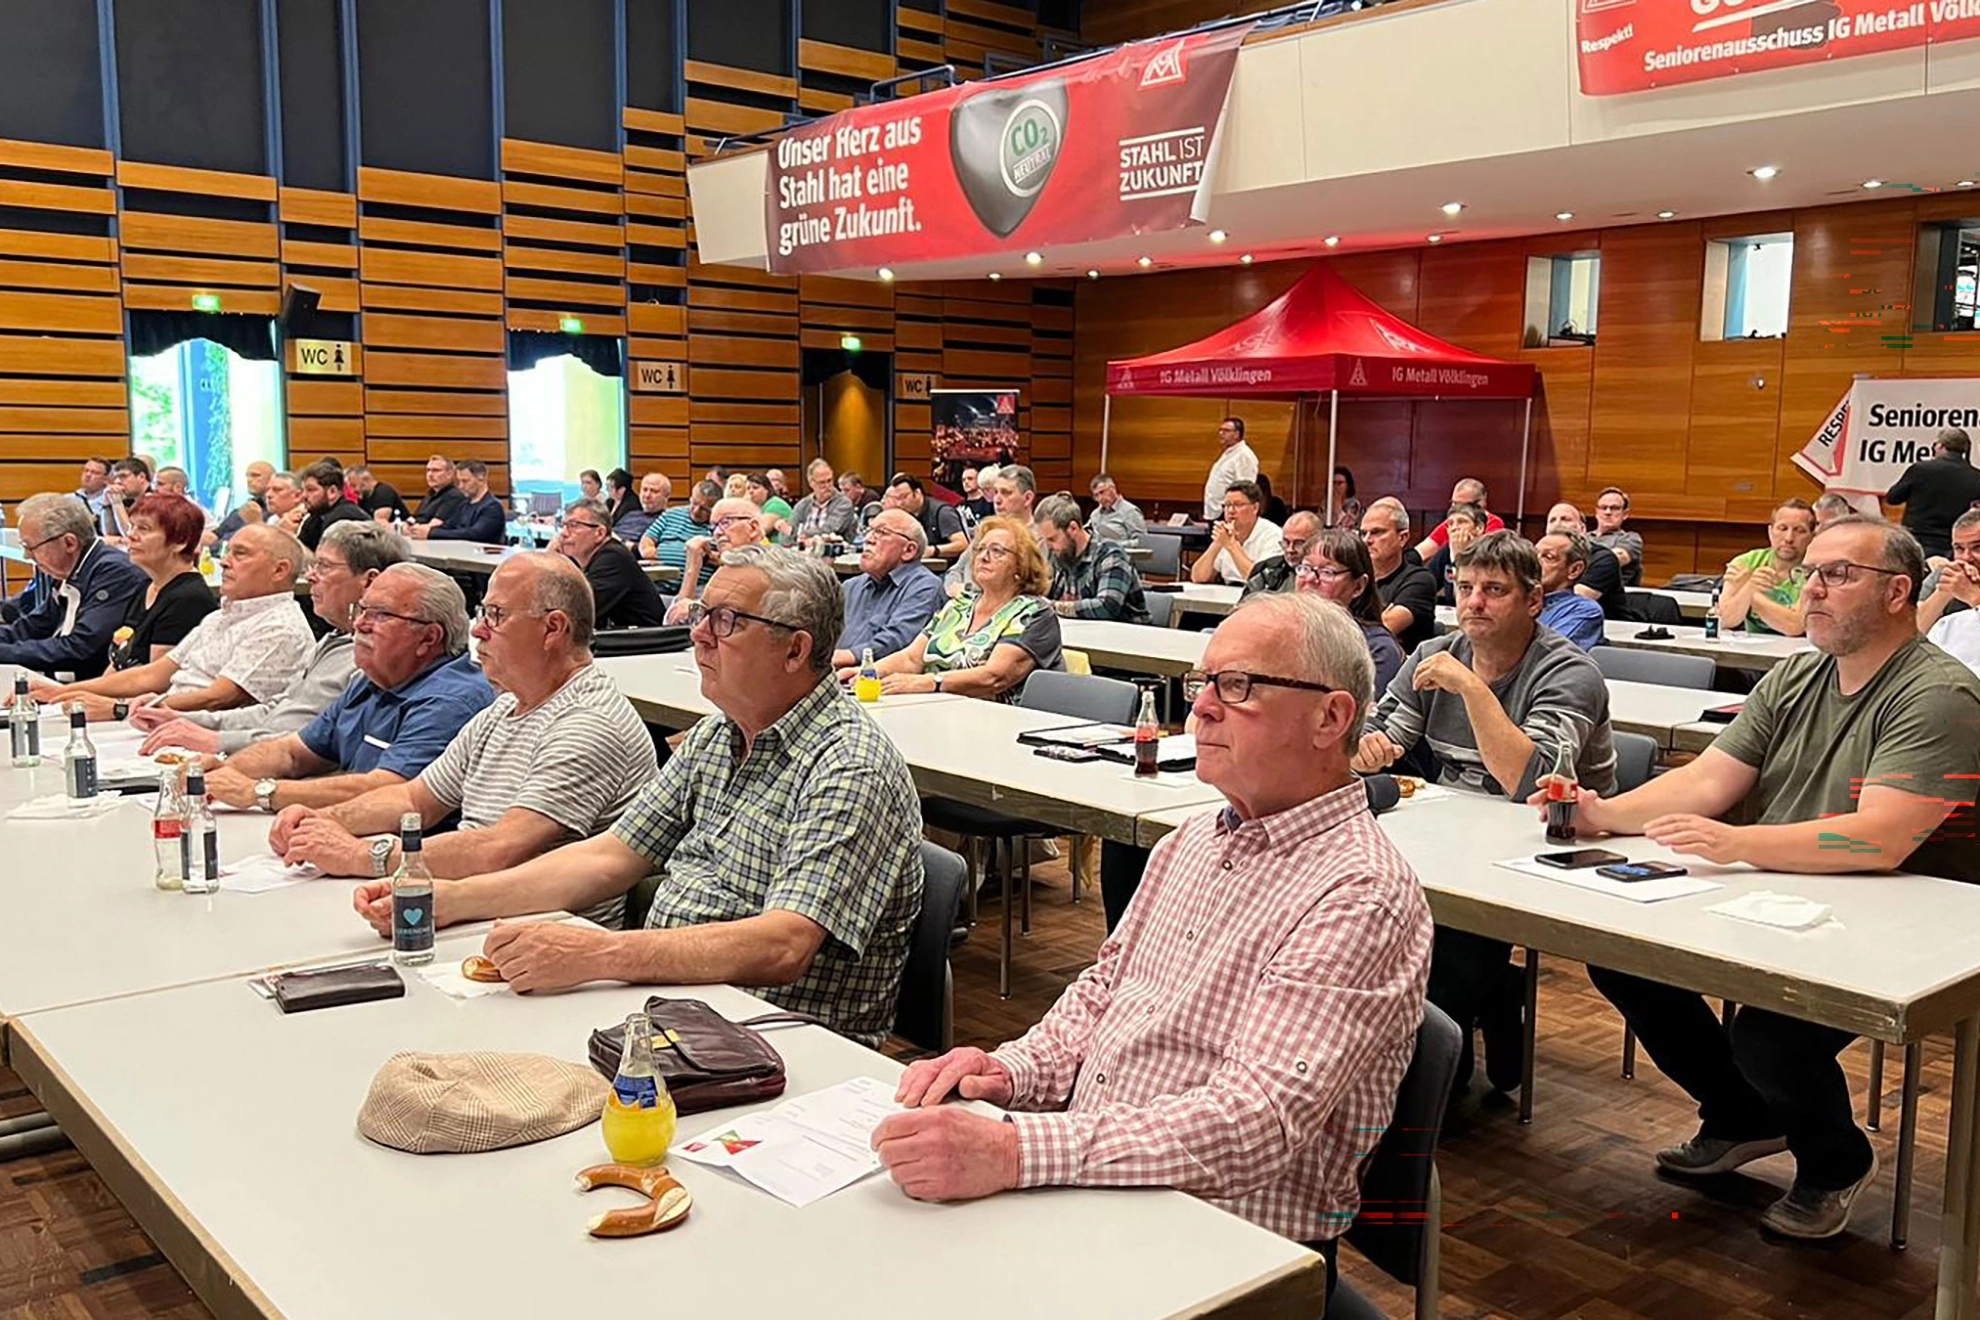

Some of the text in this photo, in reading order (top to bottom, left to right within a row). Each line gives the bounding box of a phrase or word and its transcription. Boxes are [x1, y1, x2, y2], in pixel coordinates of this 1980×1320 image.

[1580, 23, 1634, 53] Respekt!
[1644, 25, 1824, 71] Seniorenausschuss
[1828, 16, 1850, 40] IG
[1854, 3, 1925, 36] Metall
[778, 117, 922, 169] Unser Herz aus
[1120, 135, 1205, 169] STAHL IST
[779, 157, 909, 209] Stahl hat eine
[1119, 161, 1204, 192] ZUKUNFT
[779, 196, 922, 256] grüne Zukunft.
[301, 348, 328, 365] WC
[641, 369, 662, 384] WC
[905, 379, 922, 393] WC
[1159, 367, 1271, 385] IG Metall Völklingen
[1392, 367, 1489, 388] IG Metall Völklingen
[1868, 403, 1980, 427] Senioren
[1859, 440, 1886, 463] IG
